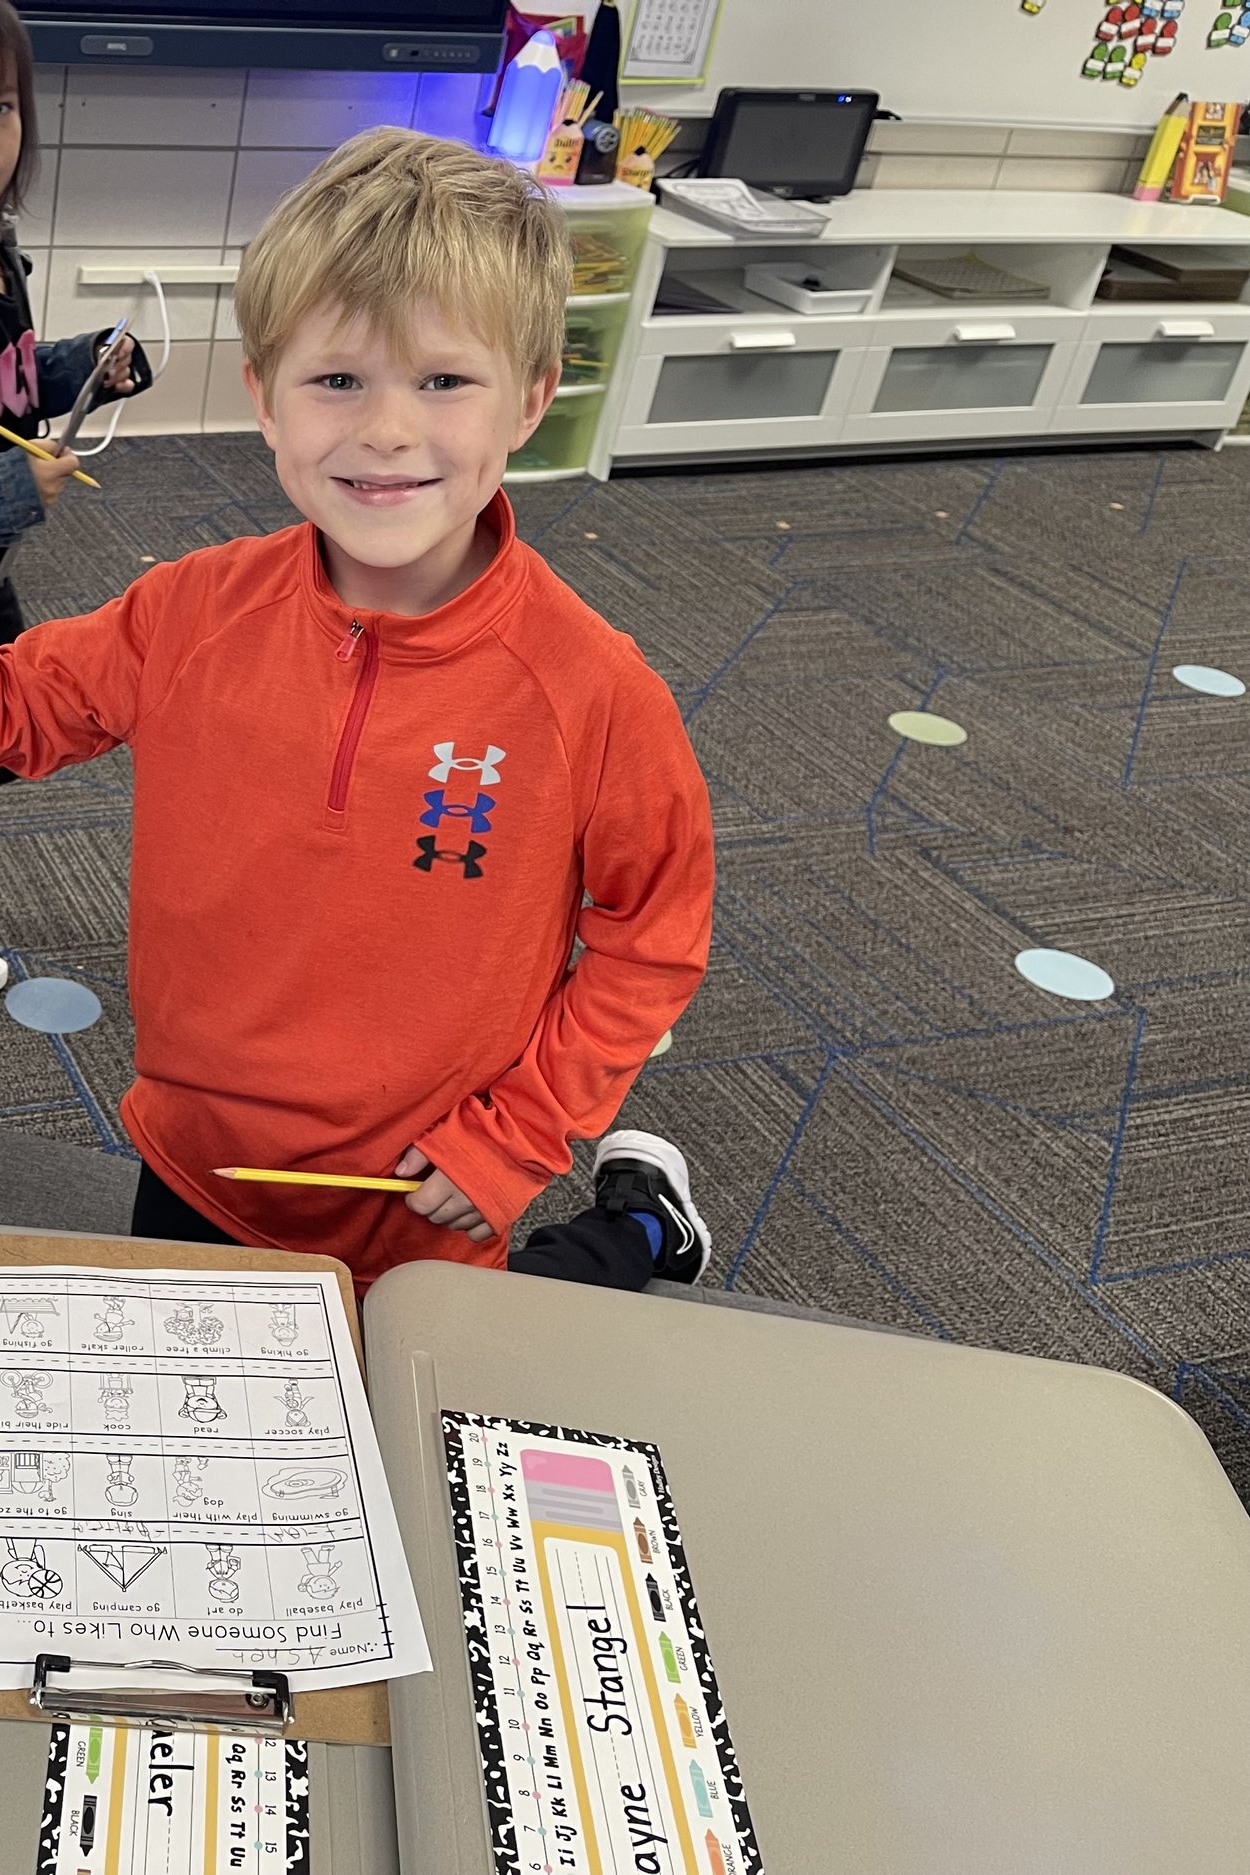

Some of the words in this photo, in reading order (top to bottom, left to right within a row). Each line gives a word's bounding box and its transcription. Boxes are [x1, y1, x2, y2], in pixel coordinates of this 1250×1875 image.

[2, 1339, 37, 1348] fishing
[81, 1343, 108, 1351] skate
[112, 1344, 144, 1352] roller
[166, 1346, 190, 1354] tree
[203, 1346, 231, 1355] climb
[261, 1347, 292, 1356] hiking
[16, 1421, 42, 1429] their
[46, 1421, 69, 1429] ride
[308, 1427, 330, 1435] play
[470, 1433, 479, 1443] 20
[497, 1442, 509, 1457] Zz
[473, 1458, 483, 1466] 19
[499, 1462, 517, 1477] Yy
[476, 1485, 486, 1493] 18
[503, 1484, 516, 1501] Xx
[637, 1480, 648, 1497] GRAY
[204, 1497, 224, 1508] dog
[16, 1507, 33, 1515] the
[38, 1507, 49, 1515] to
[54, 1507, 67, 1515] go
[111, 1508, 132, 1517] sing
[173, 1512, 201, 1520] their
[206, 1512, 231, 1520] with
[236, 1512, 258, 1521] play
[272, 1511, 330, 1521] swimming
[335, 1508, 349, 1516] go
[479, 1511, 490, 1520] 17
[507, 1507, 520, 1528] Ww
[483, 1539, 493, 1547] 16
[509, 1535, 523, 1550] Vv
[649, 1530, 660, 1554] BROWN
[487, 1566, 497, 1575] 15
[513, 1557, 526, 1573] Uu
[516, 1579, 529, 1592] Tt
[49, 1601, 72, 1610] play
[339, 1598, 363, 1608] play
[491, 1596, 501, 1605] 14
[661, 1589, 673, 1610] BLACK
[93, 1602, 142, 1612] camping
[147, 1603, 160, 1612] go
[207, 1607, 225, 1615] art
[286, 1604, 334, 1617] baseball
[519, 1600, 533, 1614] Ss
[64, 1622, 122, 1639] Likes
[130, 1623, 180, 1642] Who
[188, 1625, 287, 1643] Someone
[297, 1622, 342, 1642] Find
[495, 1625, 505, 1634] 13
[523, 1620, 538, 1636] Rr
[330, 1643, 367, 1655] Name
[527, 1642, 545, 1661] Qq
[500, 1655, 510, 1665] 12
[675, 1646, 688, 1671] GREEN
[531, 1667, 550, 1685] Pp
[565, 1605, 632, 1736] Stangel
[535, 1692, 549, 1710] Oo
[508, 1719, 520, 1729] 10
[538, 1718, 554, 1738] Nn
[689, 1706, 704, 1738] YELLOW
[76, 1740, 87, 1767] GREEN
[225, 1743, 246, 1764] Qq
[543, 1744, 559, 1768] Mm
[231, 1769, 246, 1789] Rr
[264, 1771, 277, 1782] 13
[707, 1780, 720, 1799] BLUE
[231, 1795, 246, 1813] Ss
[264, 1804, 277, 1815] 14
[550, 1797, 568, 1817] Kk
[69, 1809, 80, 1837] BLACK
[230, 1821, 246, 1839] Tt
[555, 1825, 577, 1841] Jj
[264, 1841, 277, 1853] 15
[230, 1847, 246, 1867] Uu
[558, 1849, 575, 1867] Ii
